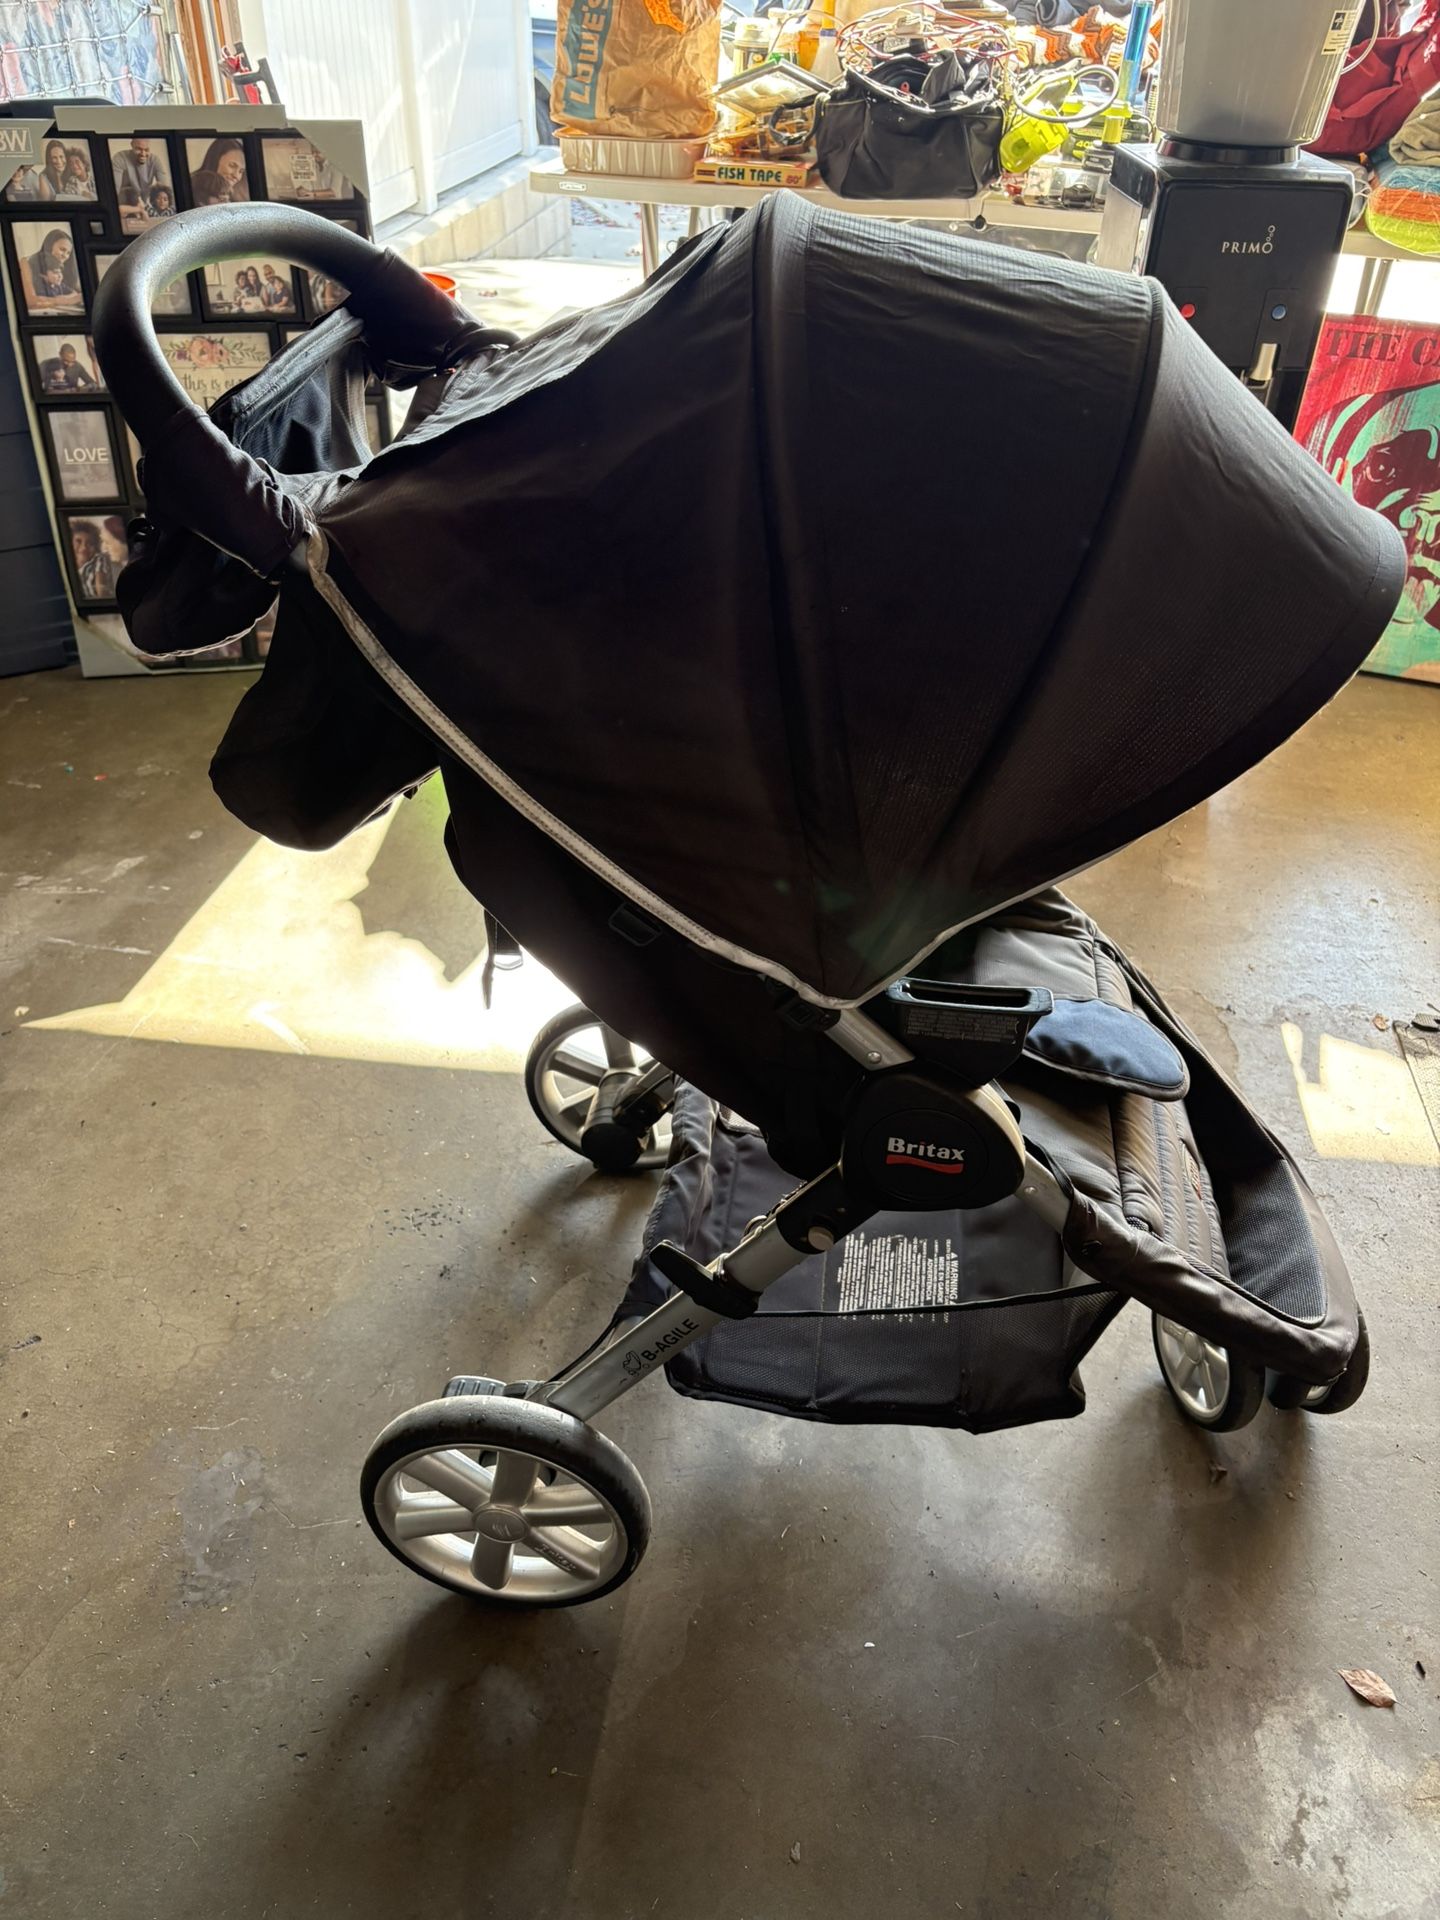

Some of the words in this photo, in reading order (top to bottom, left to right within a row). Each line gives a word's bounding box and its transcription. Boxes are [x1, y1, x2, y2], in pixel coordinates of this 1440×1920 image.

[717, 167, 745, 180] FISH
[749, 169, 782, 182] TAPE
[1221, 241, 1273, 254] PRIMO
[1326, 328, 1402, 362] THE
[1411, 336, 1440, 367] C
[181, 373, 206, 392] this
[211, 378, 222, 391] is
[64, 447, 109, 462] LOVE
[887, 1137, 966, 1161] Britax
[926, 1258, 934, 1301] ADVERTENCIA
[949, 1260, 959, 1300] WARNING
[641, 1318, 700, 1361] B-AGILE
